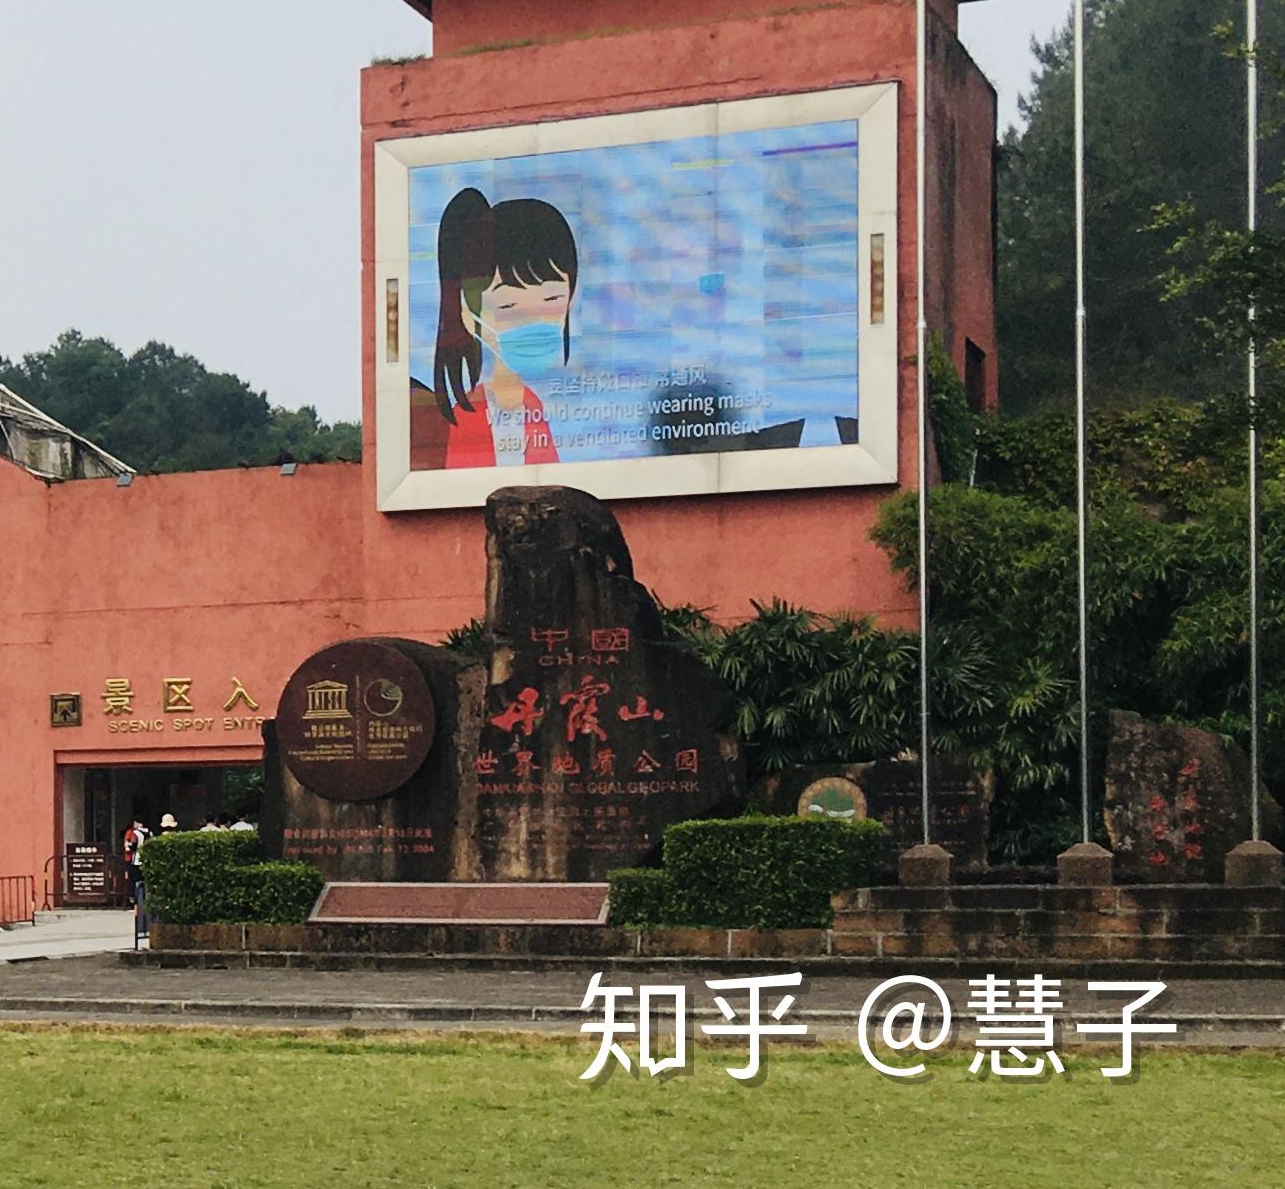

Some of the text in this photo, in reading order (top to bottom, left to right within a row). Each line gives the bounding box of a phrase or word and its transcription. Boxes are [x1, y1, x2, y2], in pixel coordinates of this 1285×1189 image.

[486, 389, 772, 426] We should continue wearing masks
[497, 433, 530, 456] stay
[533, 429, 549, 448] in
[567, 425, 648, 449] ventilated
[652, 418, 760, 441] environment
[538, 653, 620, 667] CHINA
[490, 675, 665, 743] 丹霞山
[108, 715, 275, 734] SCENIC SPOT ENTR
[471, 748, 700, 778] 世界地质公园
[627, 780, 700, 796] GEOPARK
